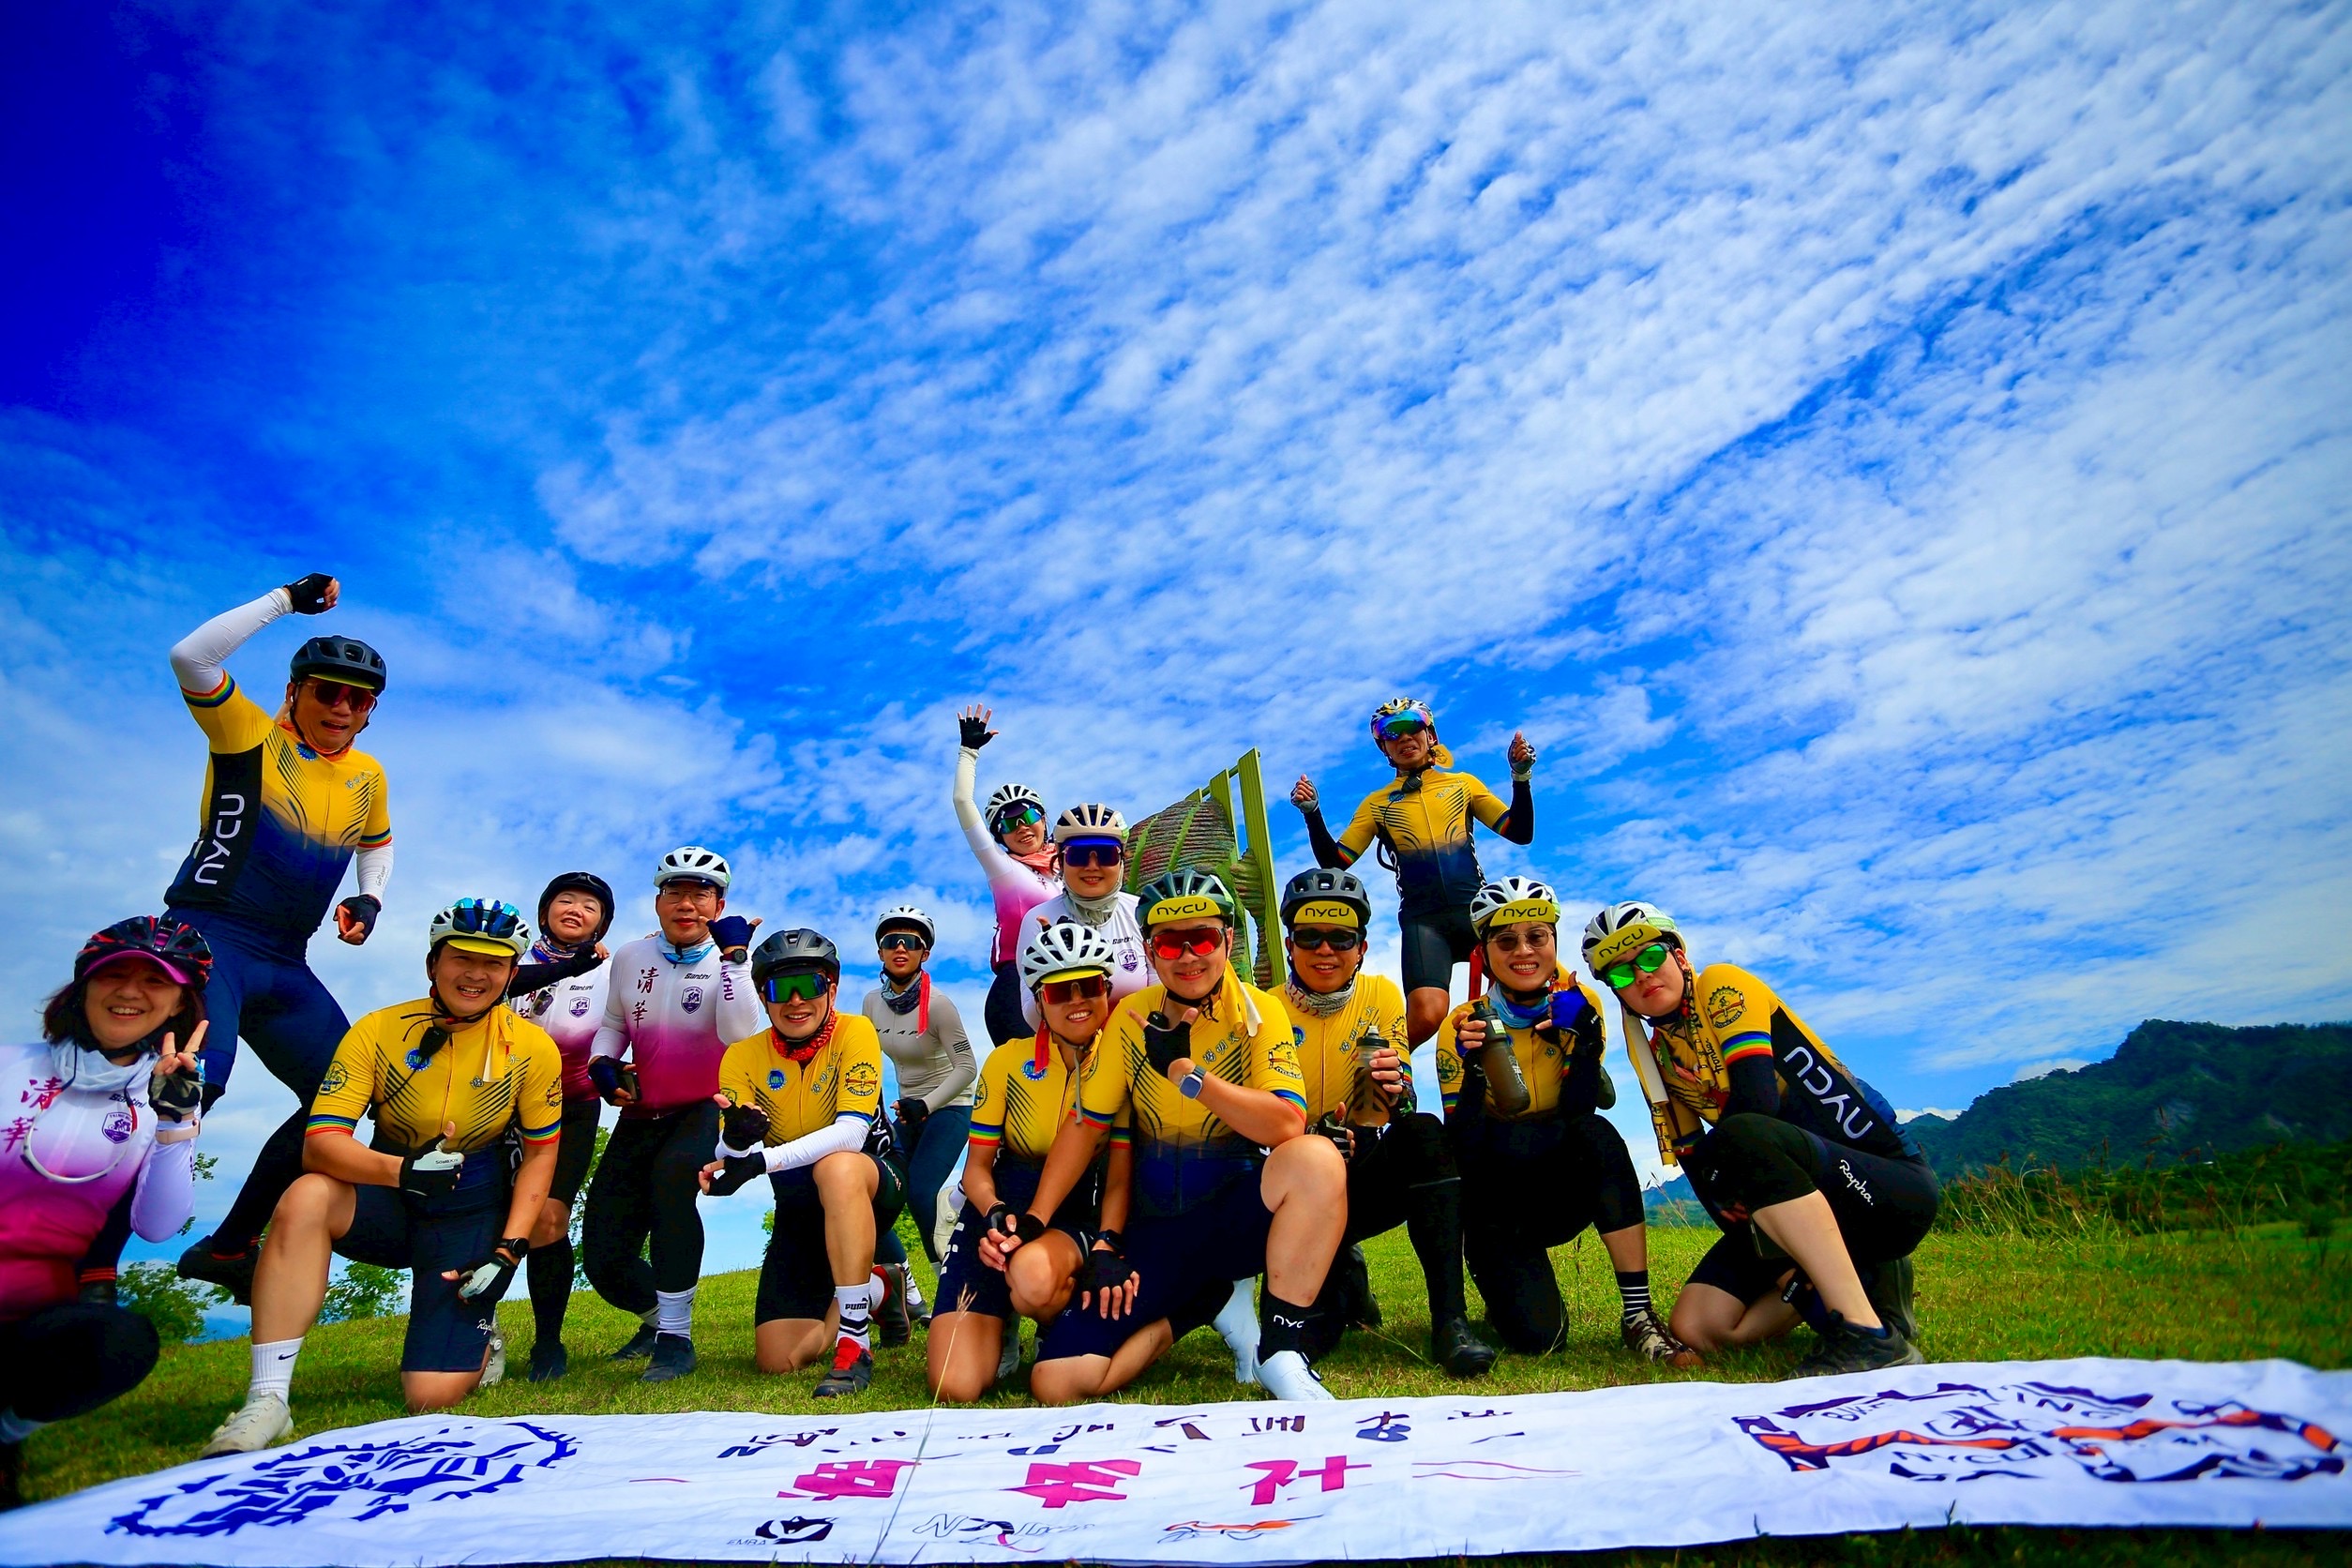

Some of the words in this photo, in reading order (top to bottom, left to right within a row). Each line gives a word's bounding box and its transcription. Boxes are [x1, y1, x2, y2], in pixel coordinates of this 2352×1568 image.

[194, 793, 246, 885] NYCU
[1156, 901, 1207, 915] NYCU
[1304, 907, 1349, 918] NYCU
[1502, 906, 1548, 917] NYCU
[1598, 927, 1644, 958] NYCU
[1783, 1046, 1874, 1139] NYCU
